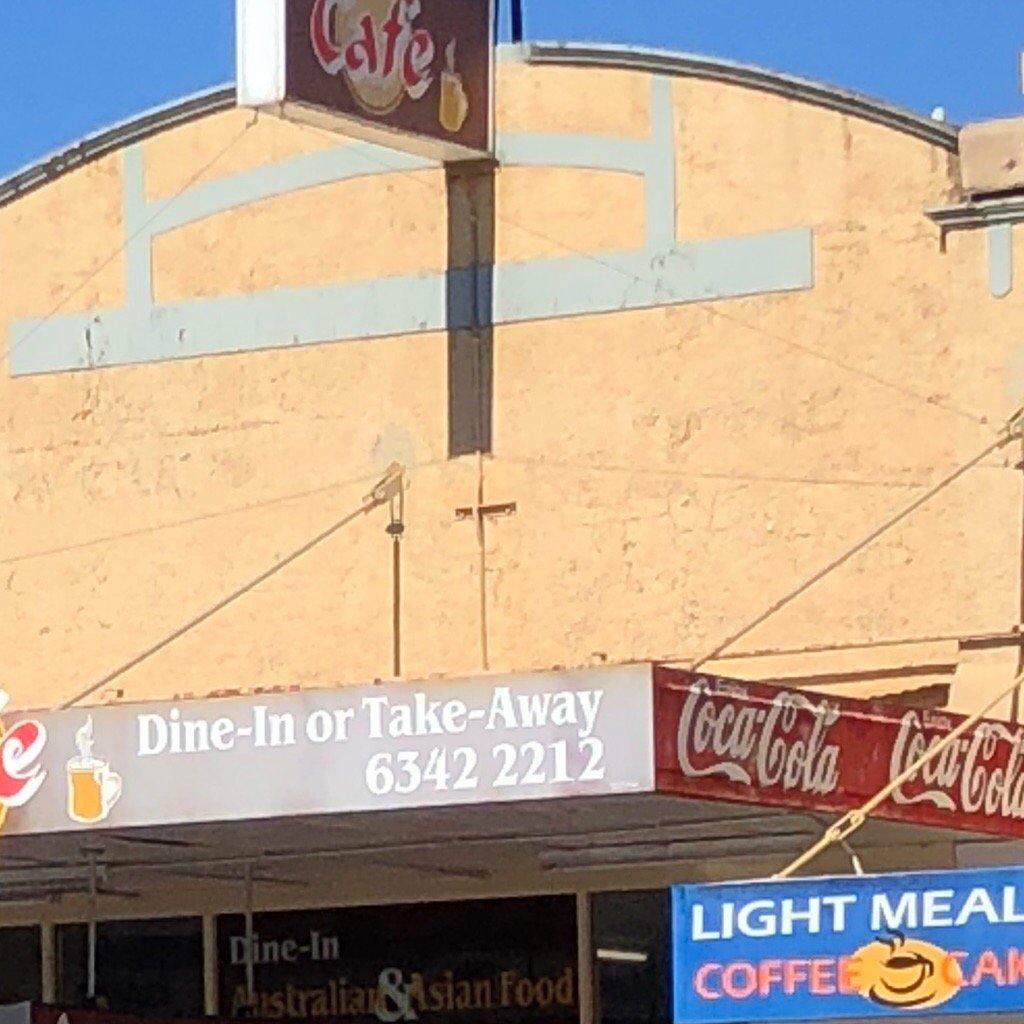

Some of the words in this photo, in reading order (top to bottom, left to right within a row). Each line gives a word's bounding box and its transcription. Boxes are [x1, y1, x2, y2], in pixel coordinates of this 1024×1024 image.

[136, 705, 296, 756] Dine-In
[306, 707, 355, 744] or
[362, 685, 604, 739] Take-Away
[365, 745, 479, 796] 6342
[493, 738, 606, 786] 2212
[691, 894, 857, 941] LIGHT
[228, 930, 340, 964] Dine-In
[500, 966, 574, 1008] Food
